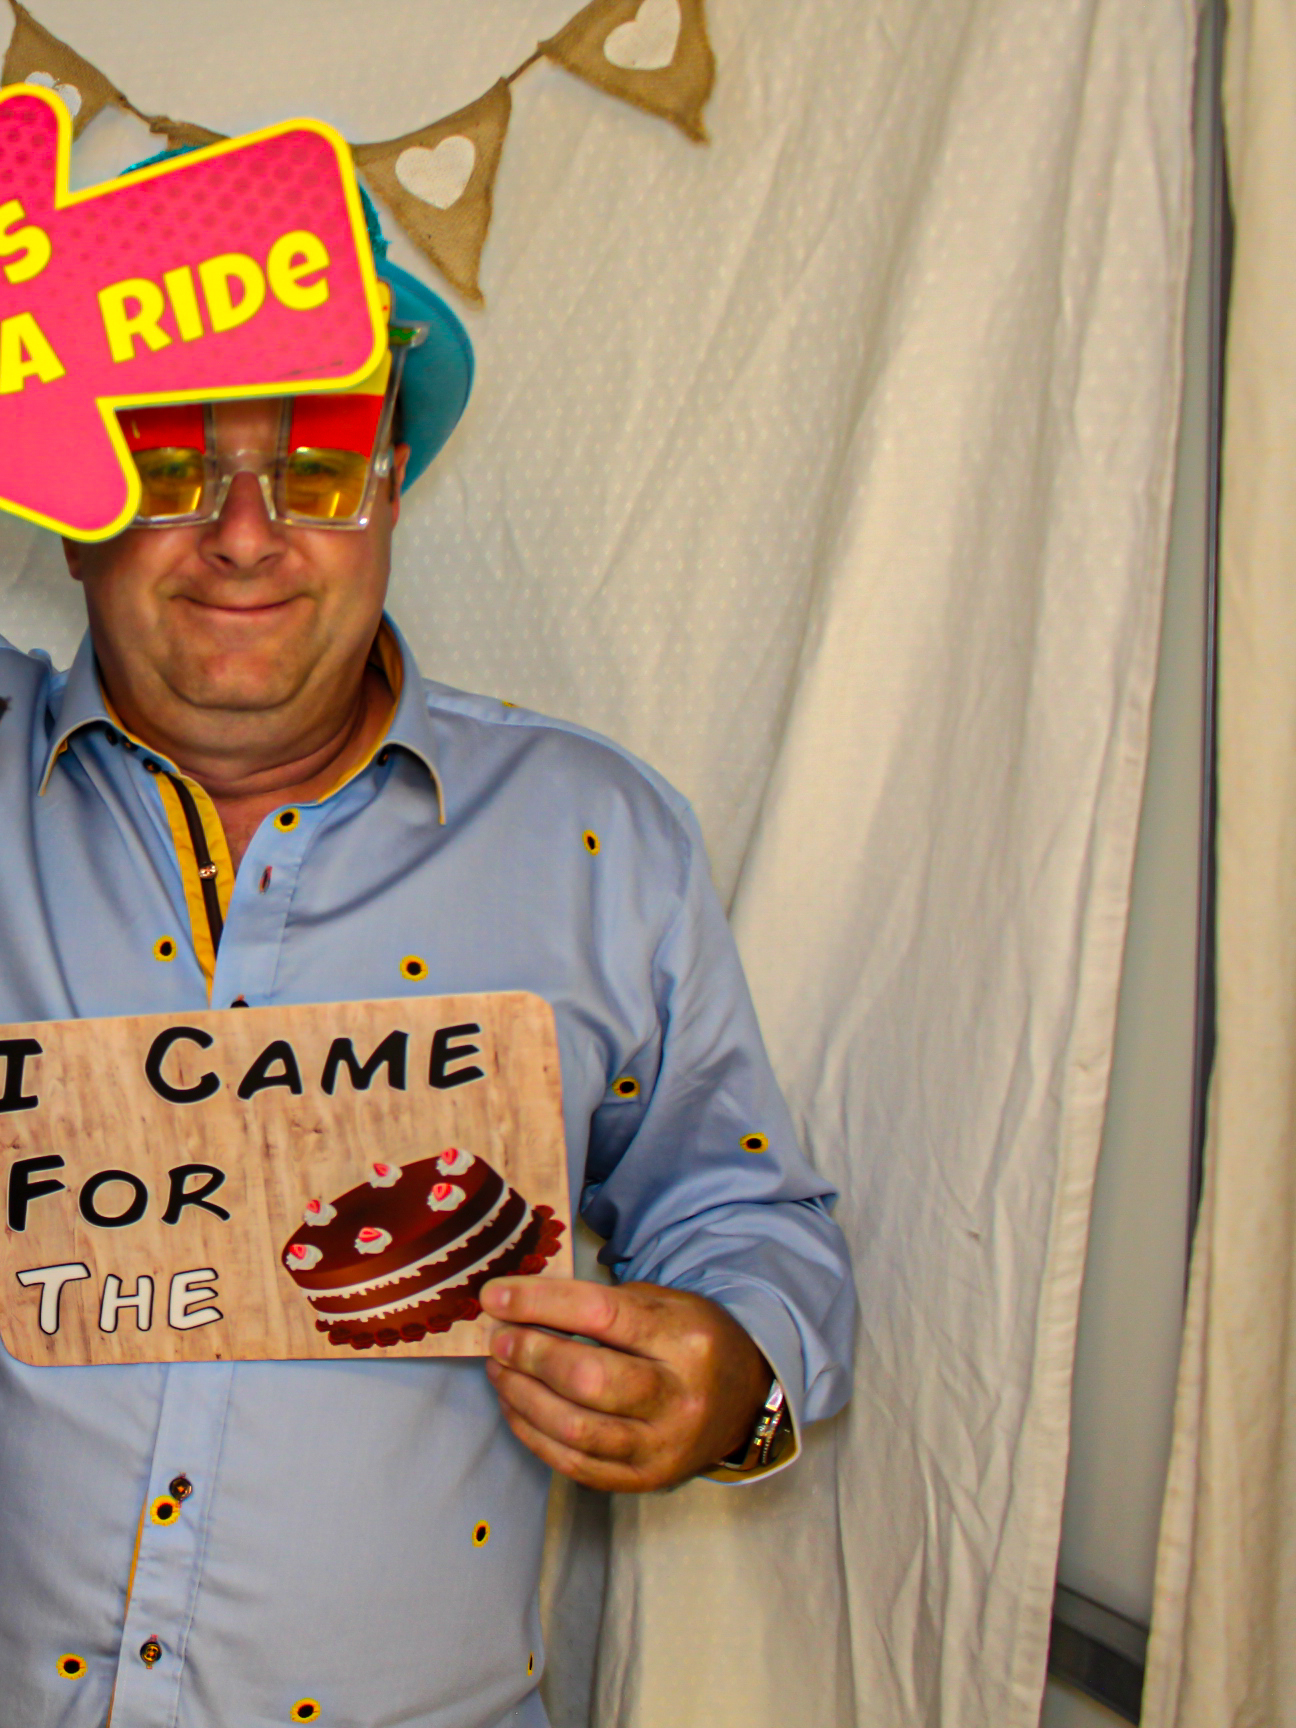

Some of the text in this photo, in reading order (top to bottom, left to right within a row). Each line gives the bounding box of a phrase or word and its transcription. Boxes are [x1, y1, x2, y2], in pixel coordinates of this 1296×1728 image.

[145, 1023, 485, 1104] CAME
[7, 1154, 231, 1232] FOR
[16, 1262, 224, 1334] THE
